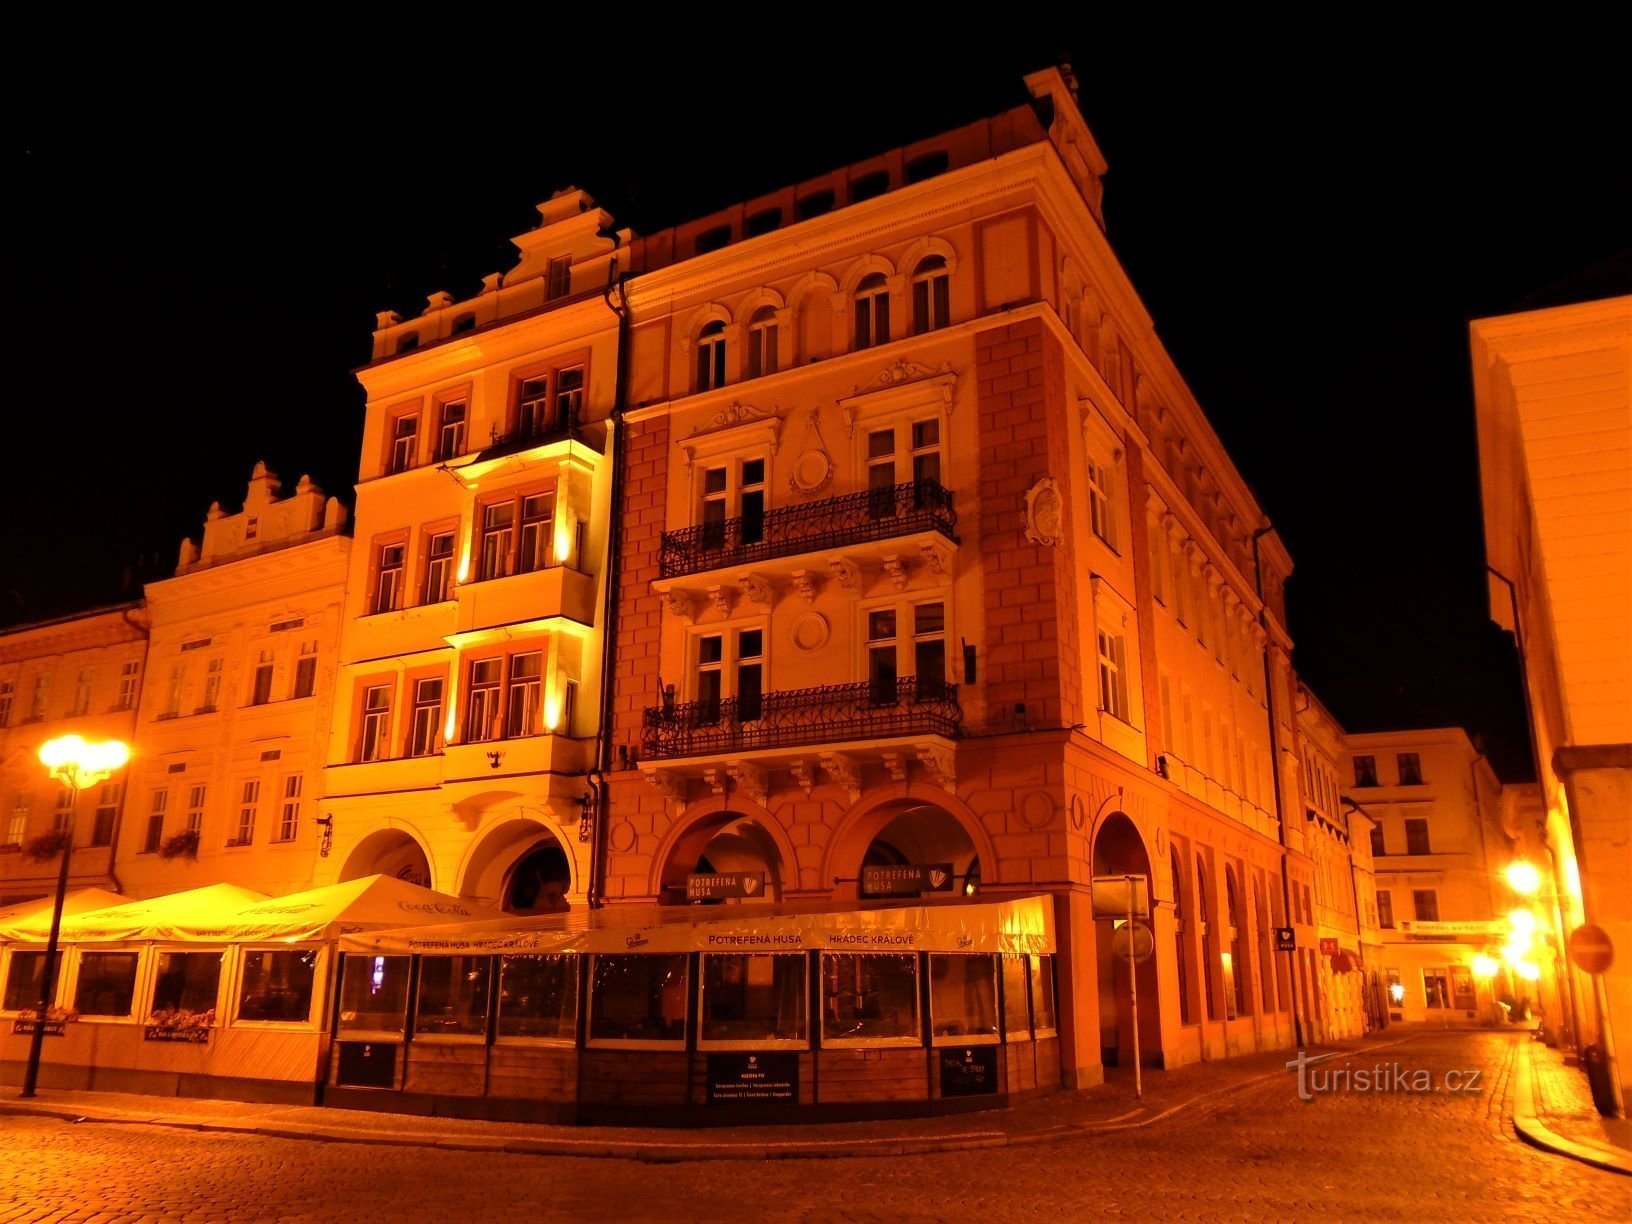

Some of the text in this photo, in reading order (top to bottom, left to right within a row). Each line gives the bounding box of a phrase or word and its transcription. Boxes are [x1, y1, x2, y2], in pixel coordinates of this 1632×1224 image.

[867, 880, 892, 891] HUSA
[689, 887, 711, 897] HUSA
[708, 934, 802, 945] POTREFENÁ HUSA
[829, 935, 869, 944] HRADEC
[450, 941, 470, 950] HUSA
